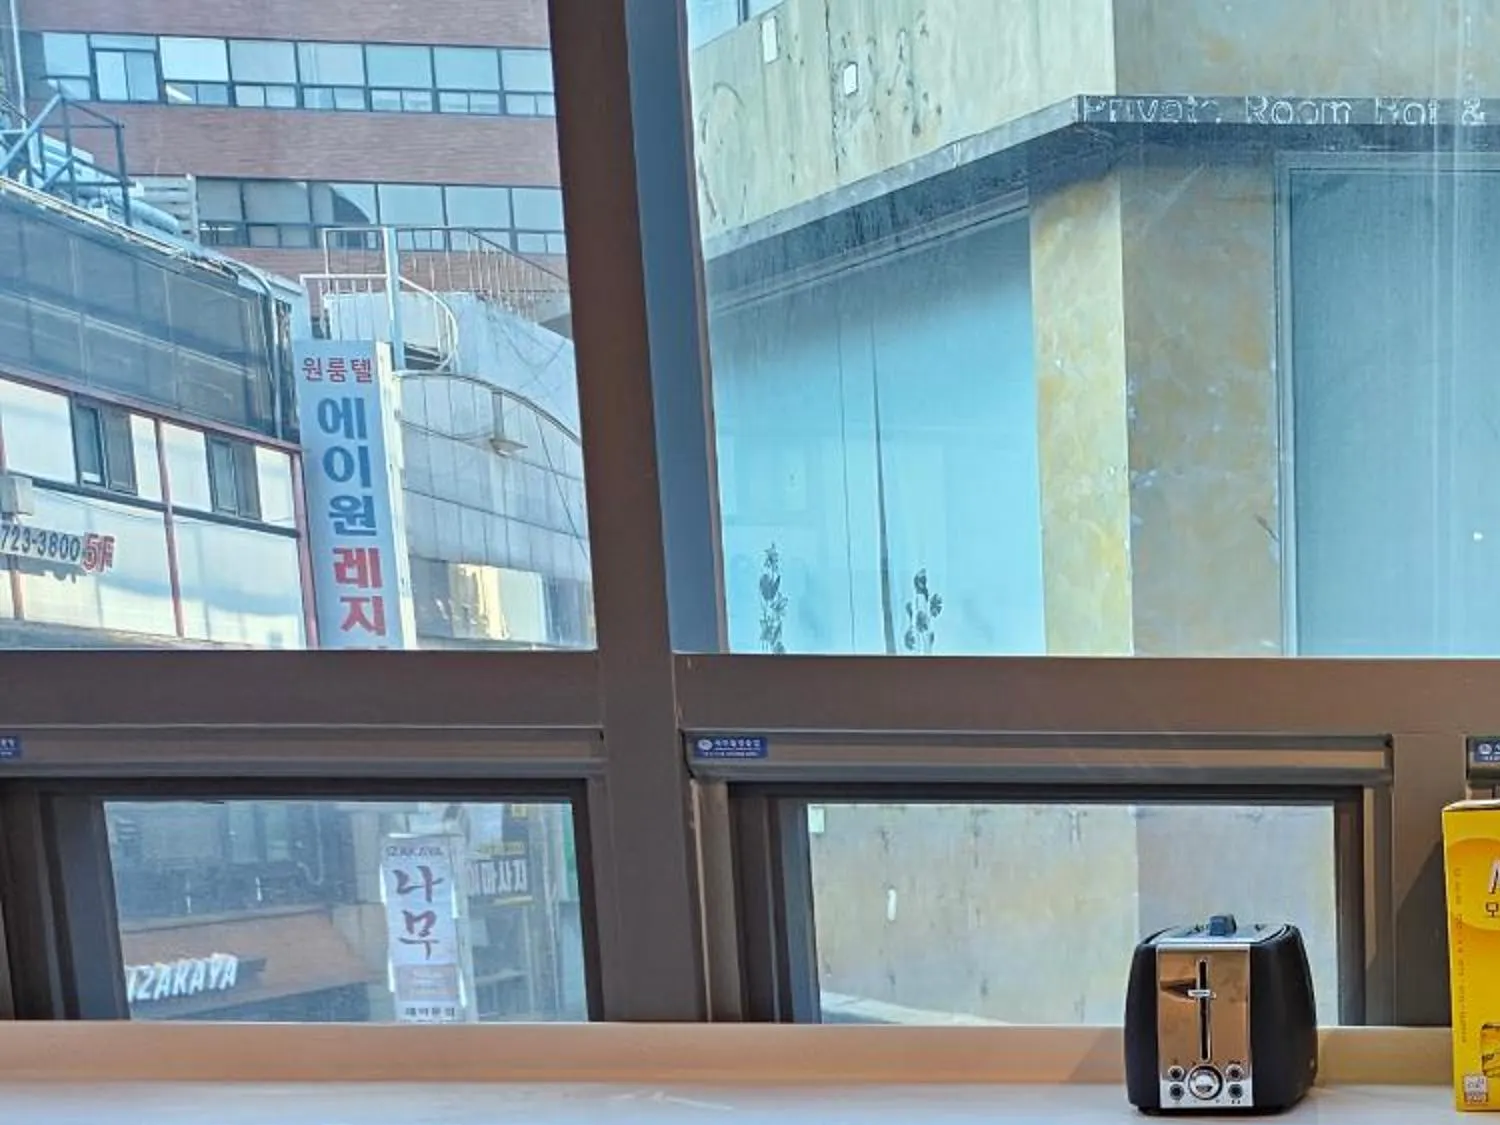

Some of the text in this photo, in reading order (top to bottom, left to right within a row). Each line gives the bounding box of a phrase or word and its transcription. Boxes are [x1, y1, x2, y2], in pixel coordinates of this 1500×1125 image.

[1245, 96, 1352, 125] Room
[302, 357, 373, 384] 원룸텔
[317, 397, 377, 536] 에이원
[0, 523, 81, 561] 723-3800
[124, 952, 239, 1003] IZAKAYA
